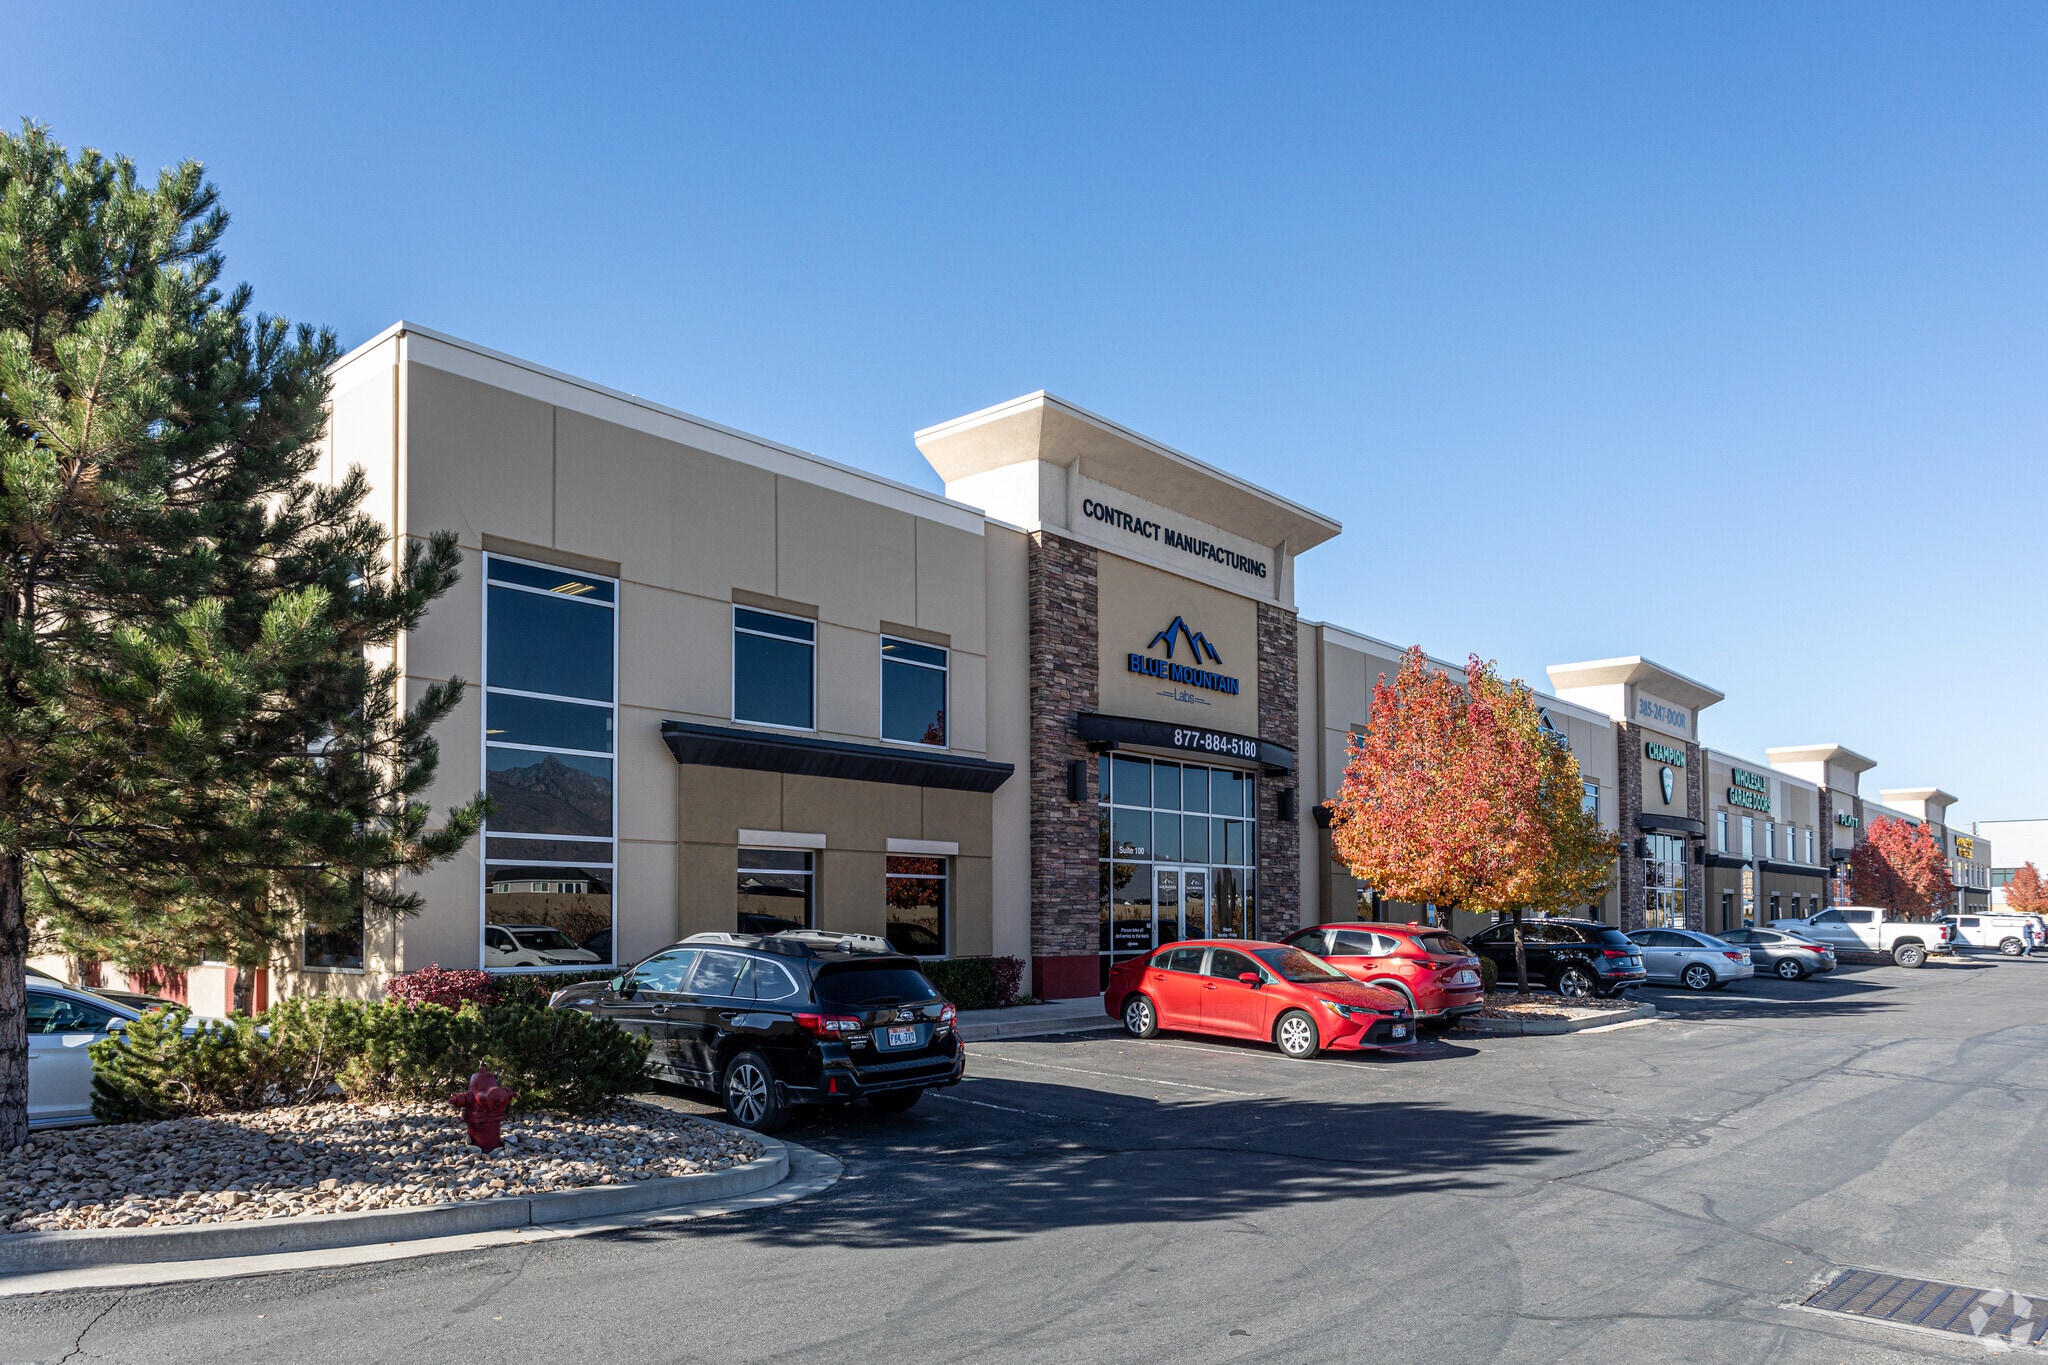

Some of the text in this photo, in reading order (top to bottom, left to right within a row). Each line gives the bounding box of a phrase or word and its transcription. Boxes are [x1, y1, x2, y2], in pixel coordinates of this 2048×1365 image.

[1083, 499, 1267, 579] CONTRACT MANUFACTURING
[1128, 653, 1239, 695] BLUE MOUNTAIN
[1174, 688, 1195, 704] Labs
[1639, 698, 1686, 729] 385-247-DOOR
[1174, 729, 1257, 758] 877-884-5180
[1645, 741, 1686, 768] CHAMPION
[1732, 767, 1767, 793] WHOLESALE
[1727, 787, 1771, 814] GARAGE DOORS
[1839, 814, 1859, 829] PLATT
[1119, 846, 1145, 855] Suite 100
